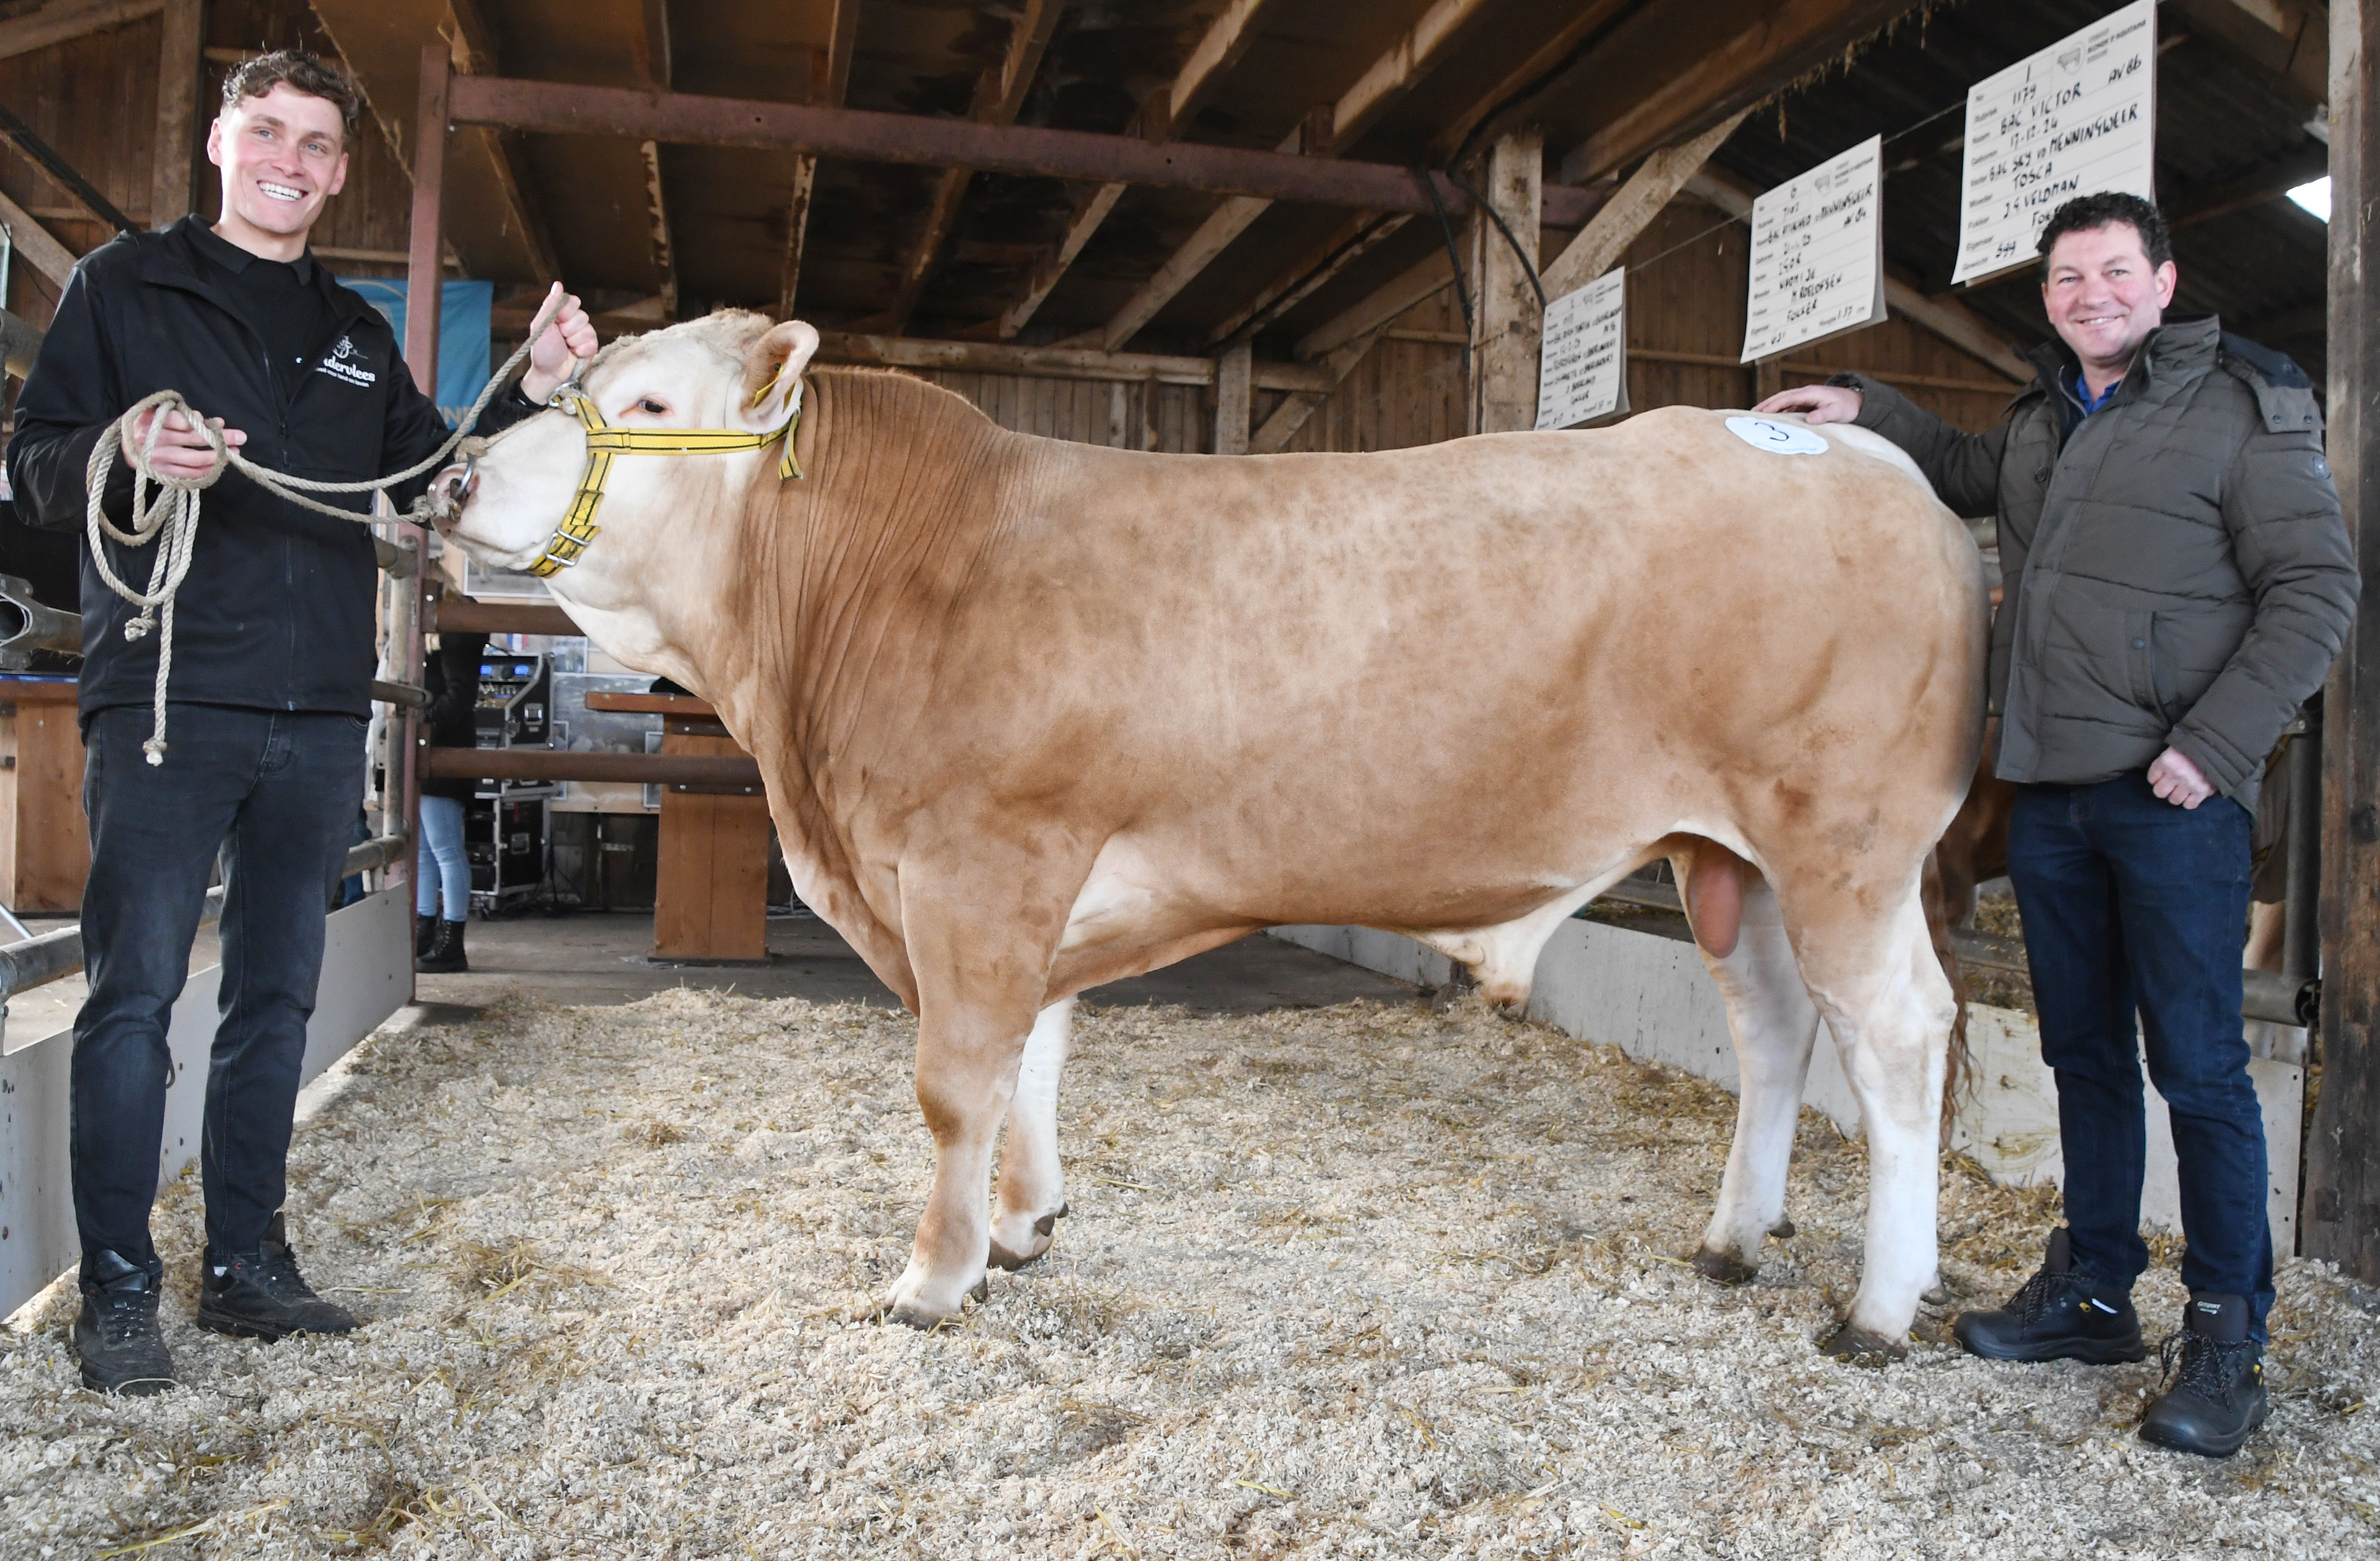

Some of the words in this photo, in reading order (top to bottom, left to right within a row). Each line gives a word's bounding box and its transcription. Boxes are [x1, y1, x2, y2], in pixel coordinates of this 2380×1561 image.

[2031, 81, 2081, 117] VICTOR
[2013, 161, 2053, 190] TOSCA
[2024, 174, 2079, 208] VELDMAN
